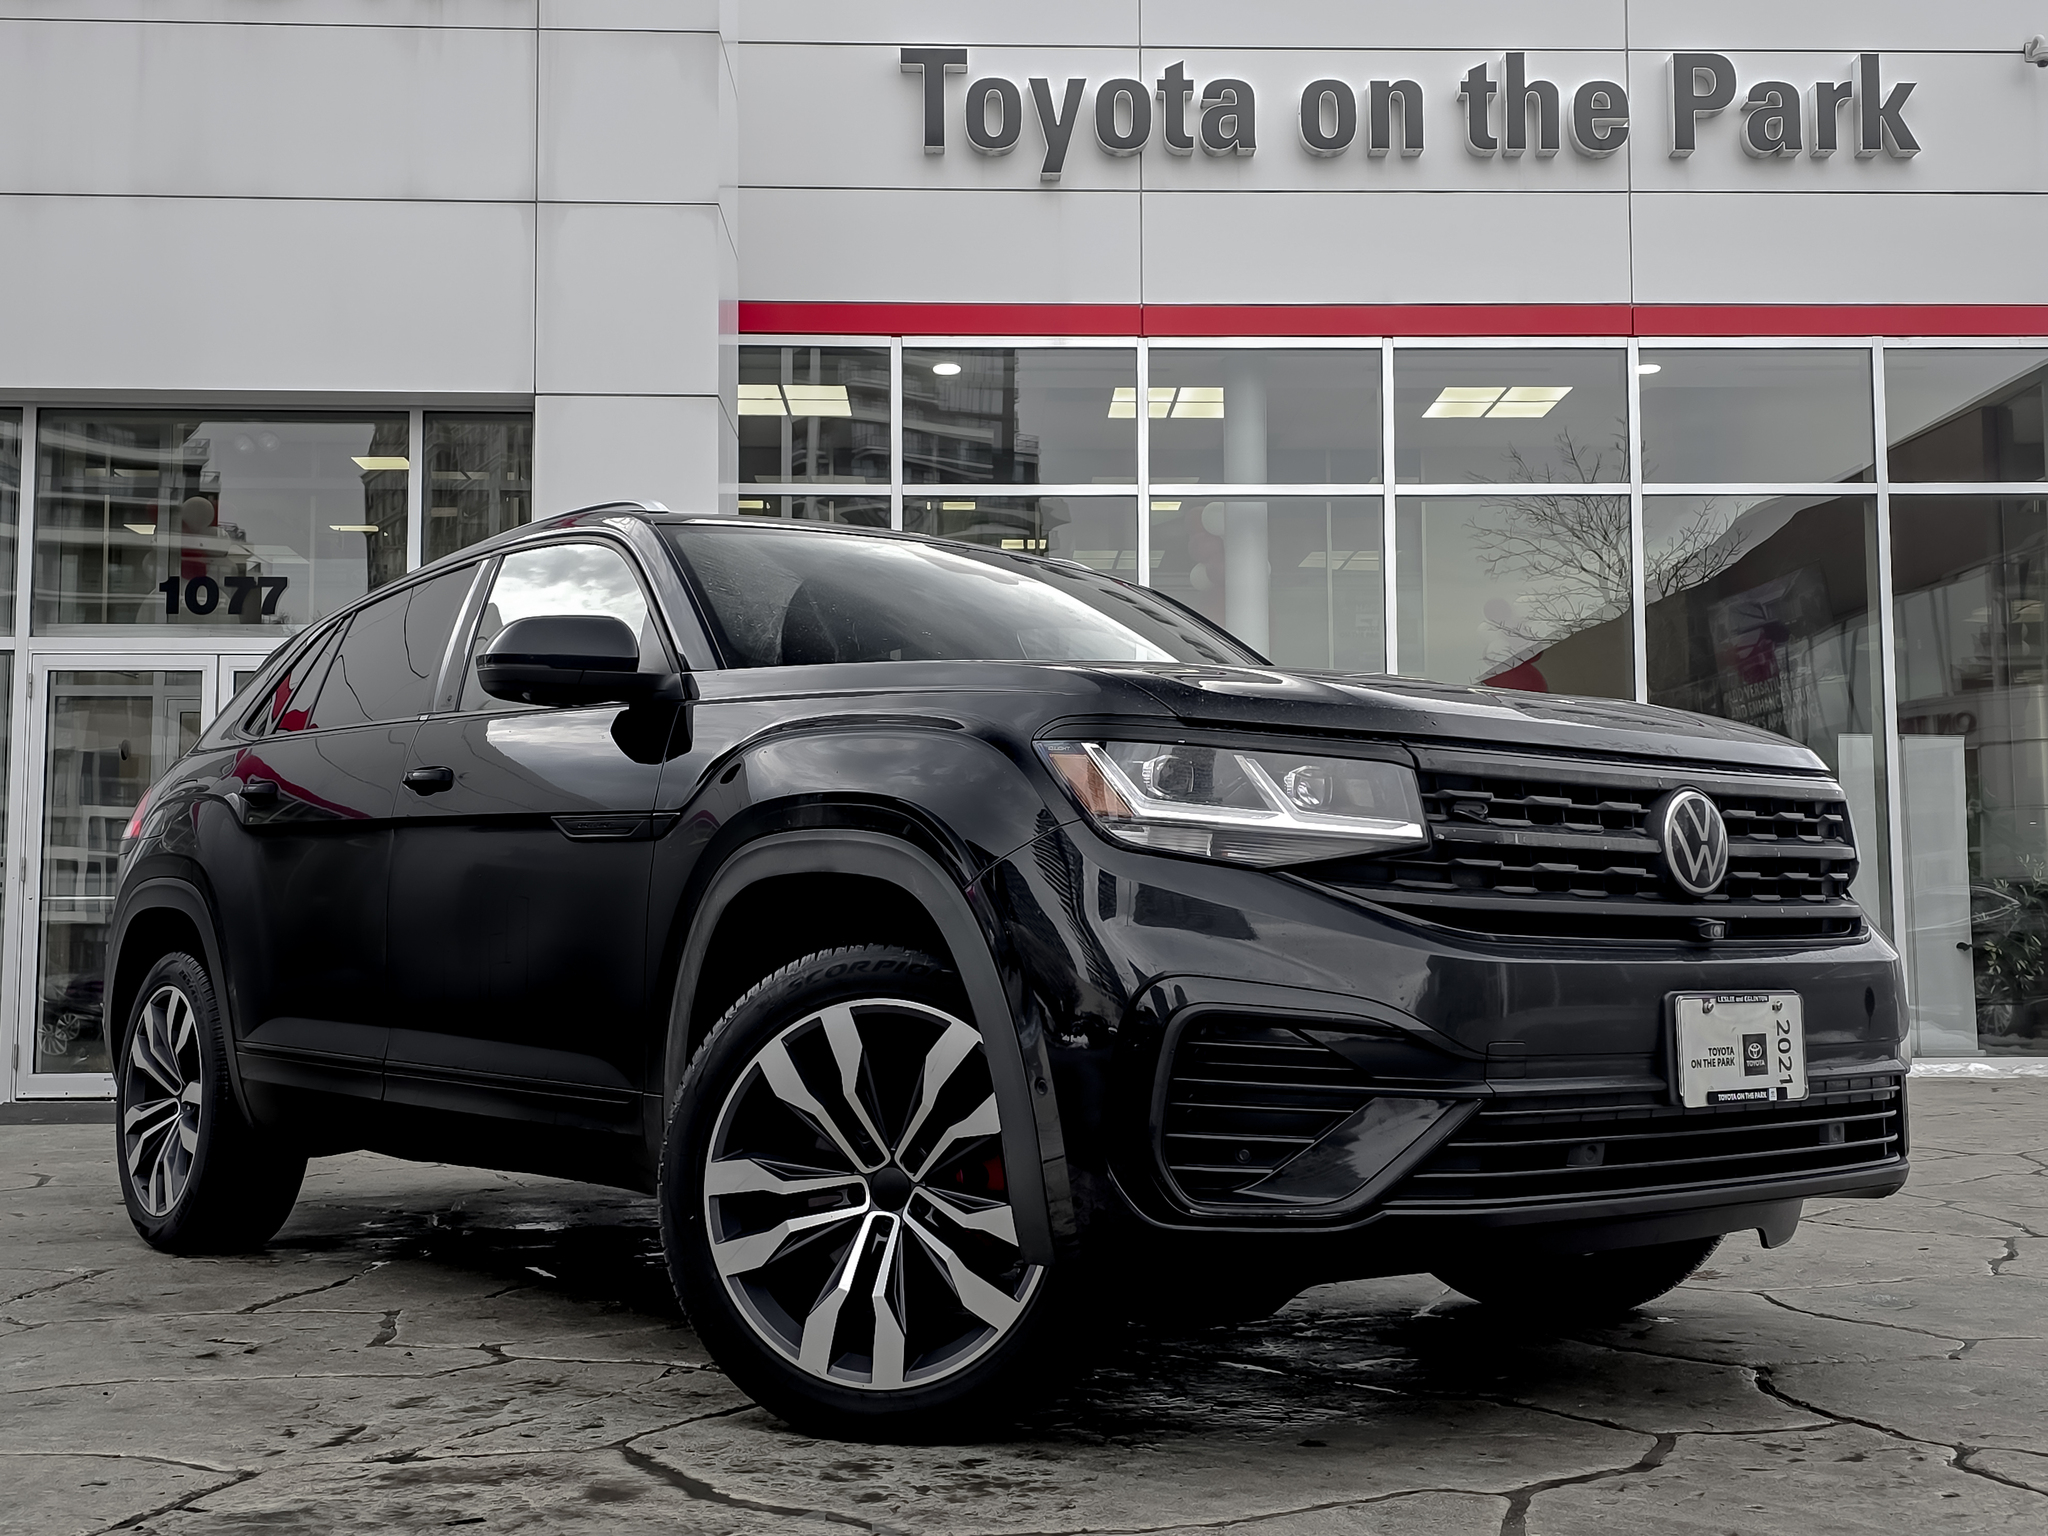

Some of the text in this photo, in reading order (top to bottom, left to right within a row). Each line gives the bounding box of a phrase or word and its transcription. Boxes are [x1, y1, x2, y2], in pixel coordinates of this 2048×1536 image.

[900, 48, 1921, 181] Toyota on the Park
[159, 576, 288, 615] 1077
[1690, 1056, 1735, 1069] ON THE PARK
[1708, 1046, 1735, 1057] TOYOTA
[1776, 1019, 1794, 1085] 2021
[1717, 1093, 1737, 1102] TOYOTA
[1736, 1092, 1745, 1100] ON
[1745, 1091, 1754, 1100] THE
[1754, 1090, 1767, 1099] PARK
